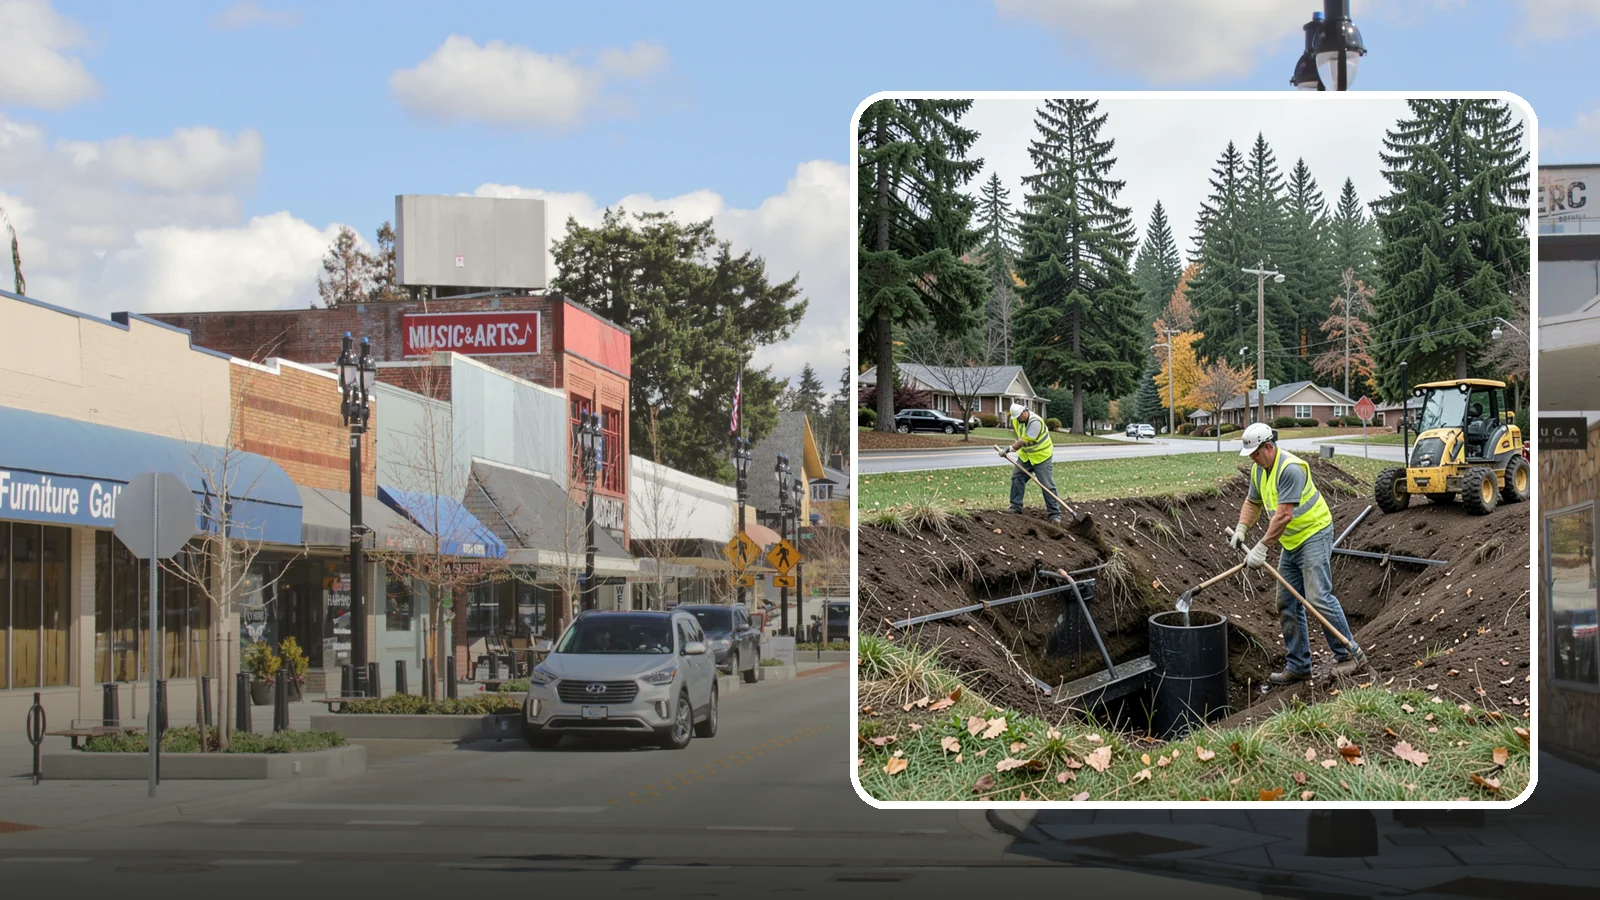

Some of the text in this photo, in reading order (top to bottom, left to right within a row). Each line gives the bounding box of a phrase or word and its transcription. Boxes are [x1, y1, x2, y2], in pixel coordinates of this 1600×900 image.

[408, 322, 520, 349] MUSIC&ARTS
[1540, 427, 1578, 437] UGA
[0, 471, 122, 519] Furniture Gal
